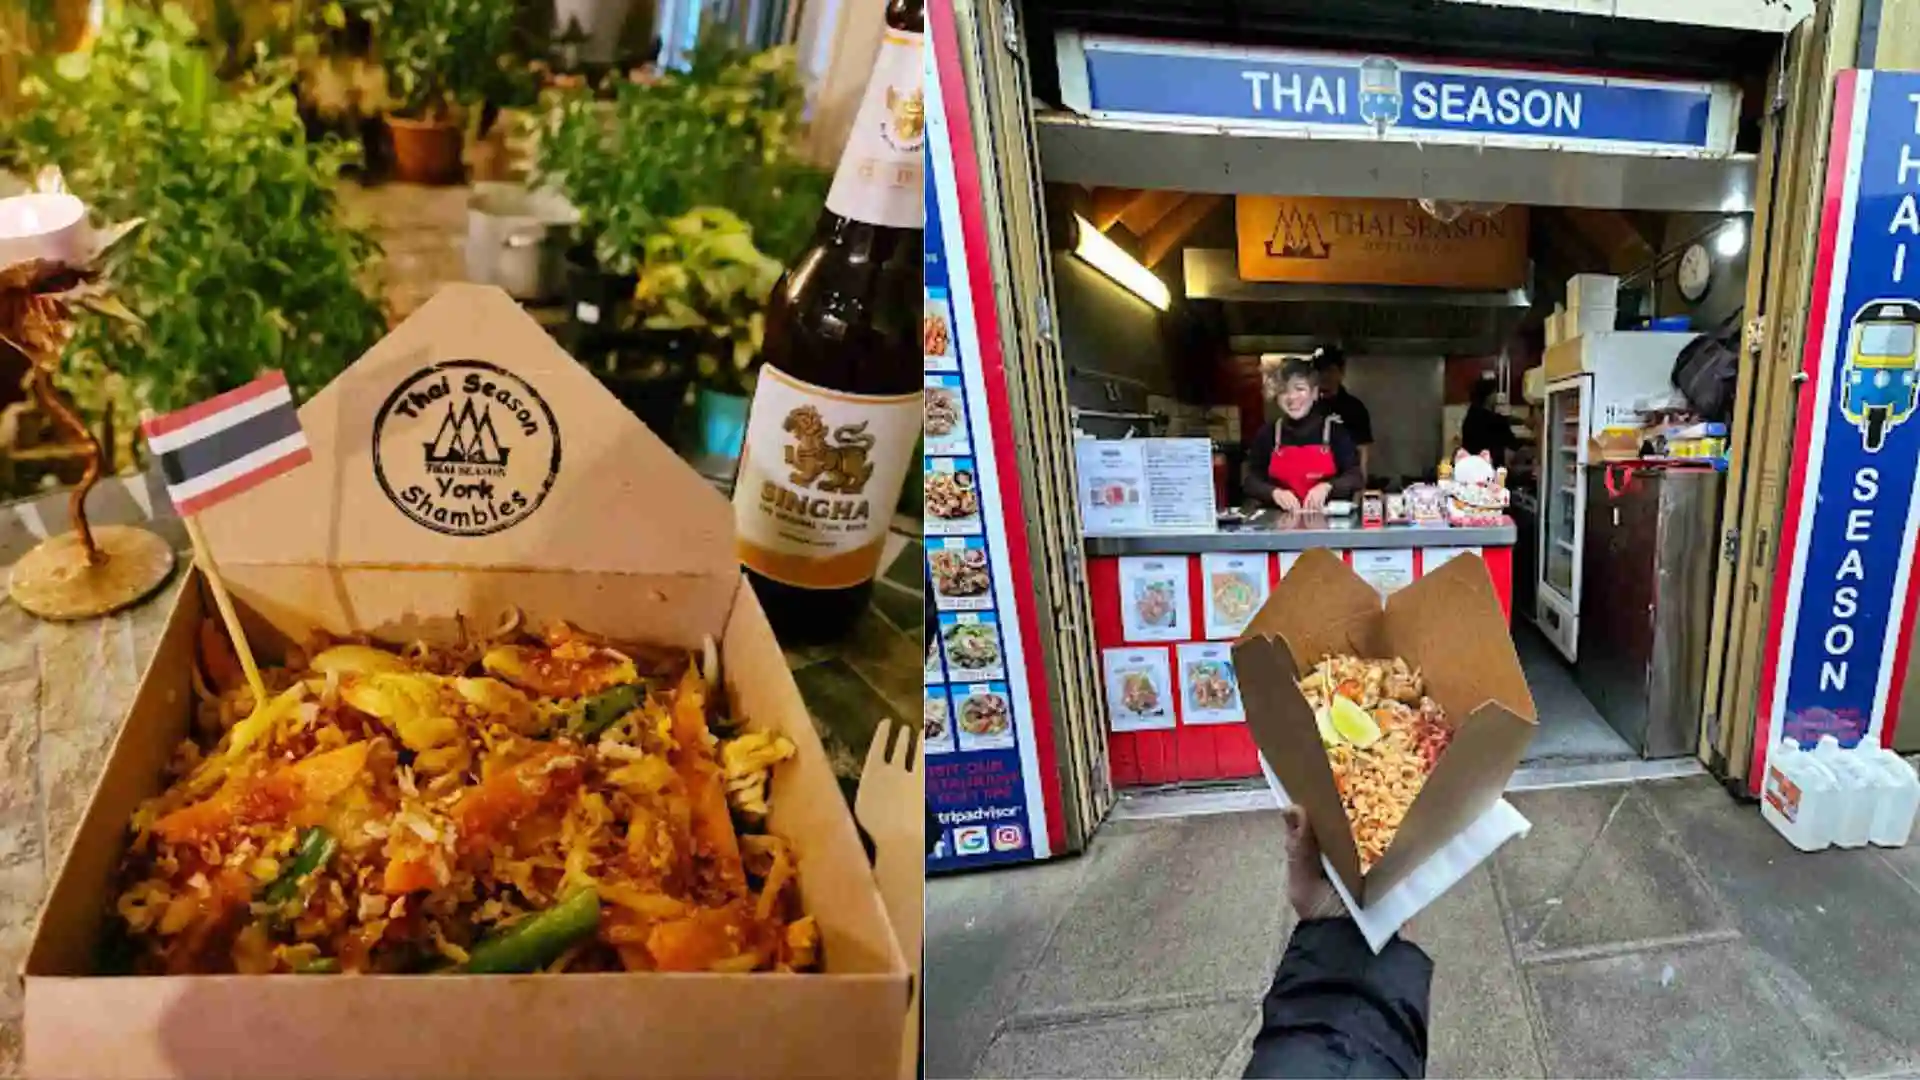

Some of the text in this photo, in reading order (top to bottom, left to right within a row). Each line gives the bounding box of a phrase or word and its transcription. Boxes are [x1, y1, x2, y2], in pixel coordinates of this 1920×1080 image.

[1242, 71, 1583, 130] THAI SEASON
[1330, 211, 1394, 236] THAI
[394, 373, 539, 437] Thai Season
[401, 485, 527, 527] Shambles
[436, 477, 495, 500] York
[760, 480, 870, 521] SINGHA
[1820, 467, 1880, 692] SEASON
[937, 805, 1017, 825] tripadvisor
